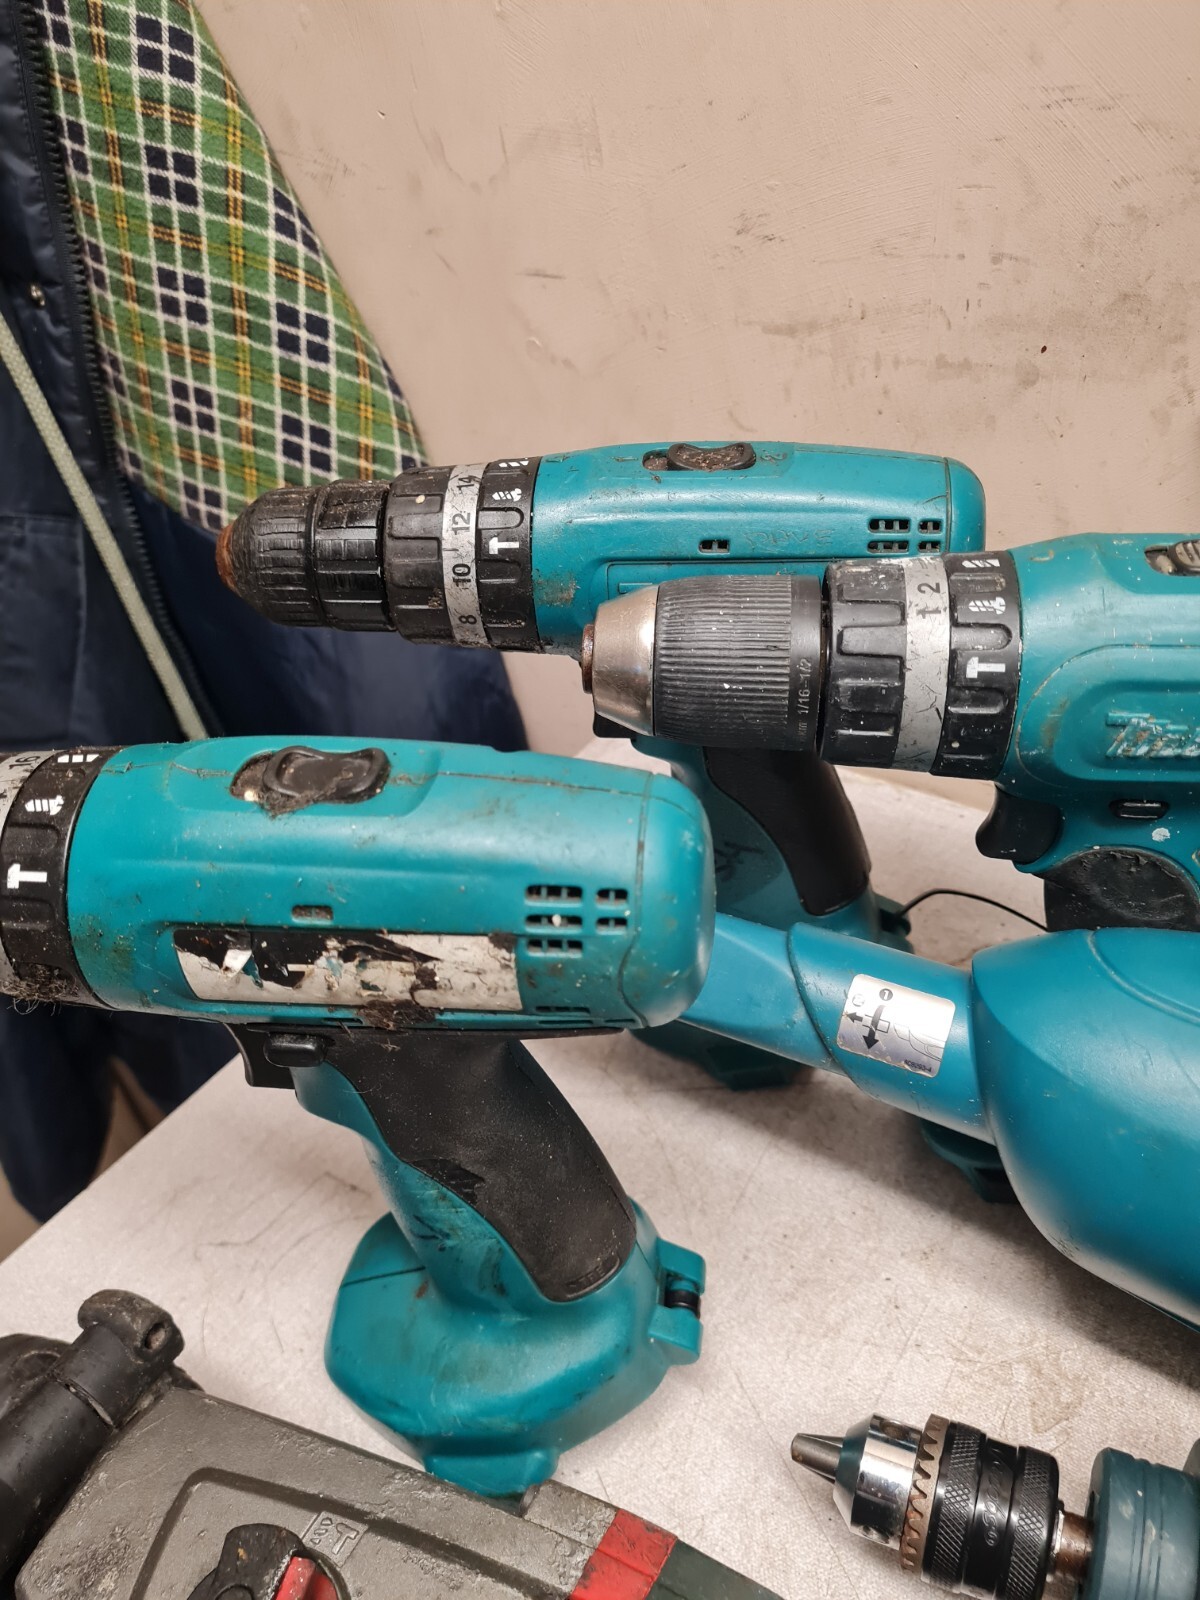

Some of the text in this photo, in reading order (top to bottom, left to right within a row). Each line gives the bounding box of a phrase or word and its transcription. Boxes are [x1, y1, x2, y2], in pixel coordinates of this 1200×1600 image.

[457, 475, 477, 491] 14
[451, 512, 471, 536] 12
[451, 563, 472, 587] 10
[917, 582, 941, 594] 2
[458, 614, 478, 625] 8
[9, 755, 41, 770] 16
